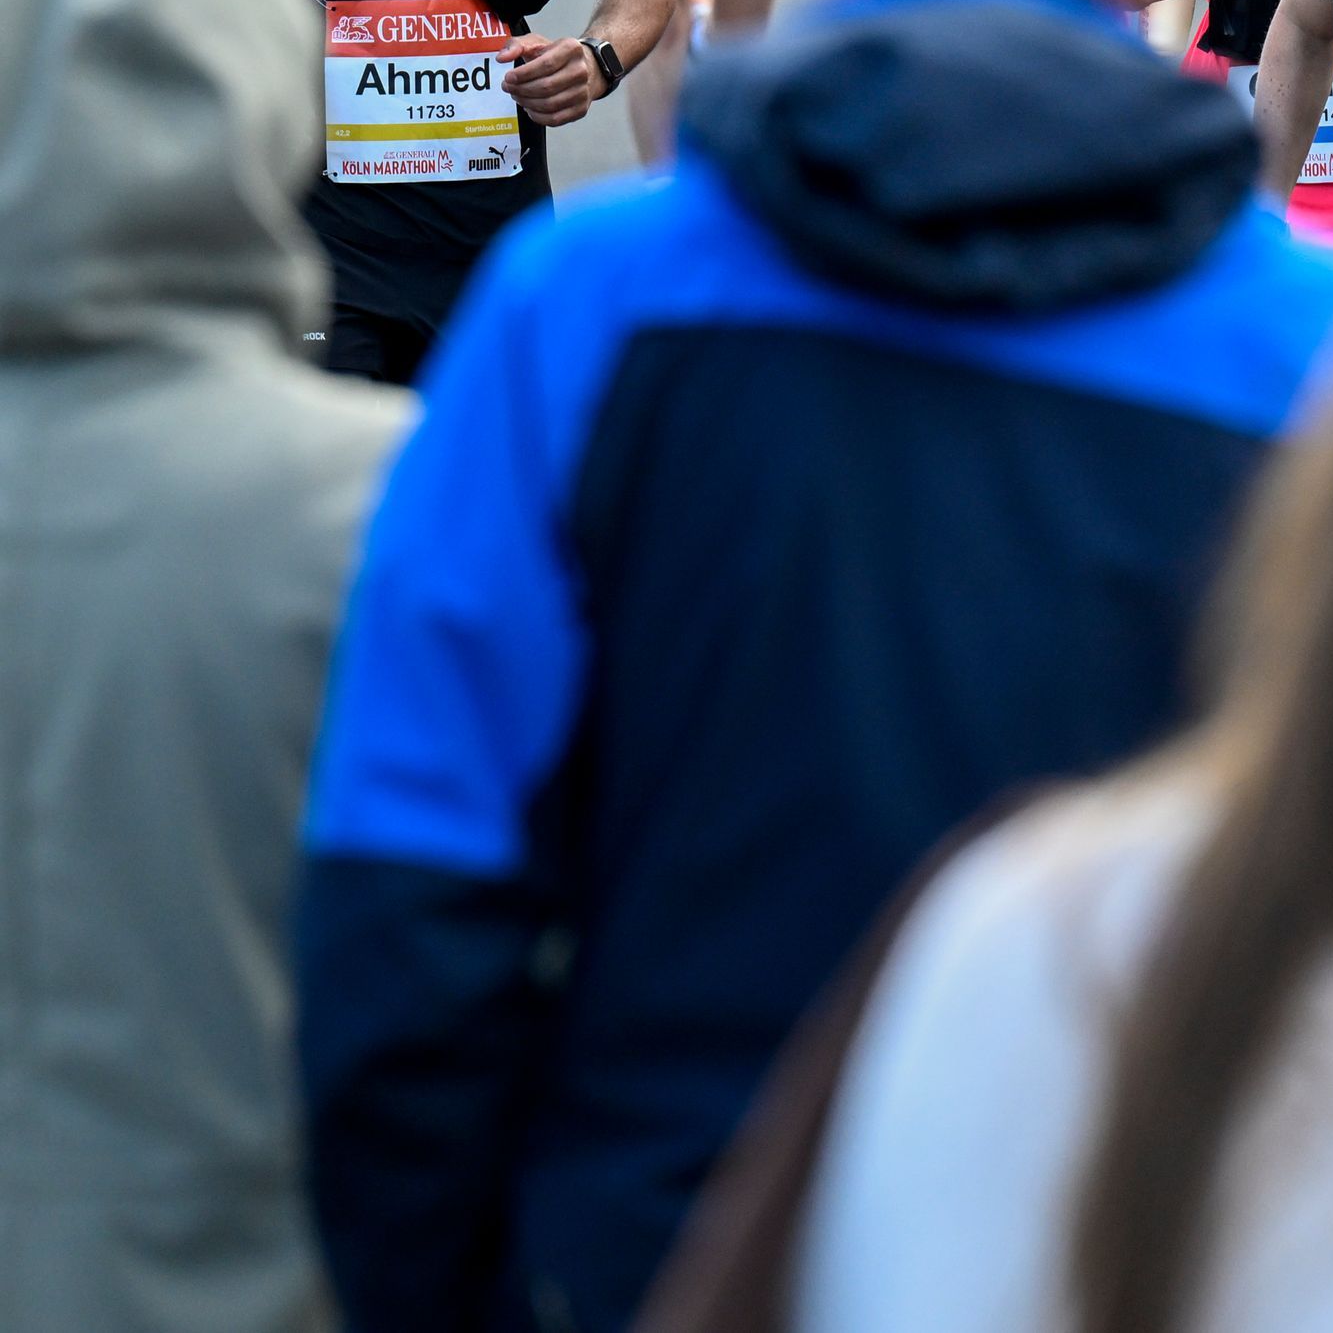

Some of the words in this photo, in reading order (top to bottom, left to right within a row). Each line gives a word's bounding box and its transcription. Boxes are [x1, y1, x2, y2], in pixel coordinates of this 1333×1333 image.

[377, 12, 507, 44] GENERALI
[356, 58, 491, 95] Ahmed
[406, 104, 455, 120] 11733
[395, 150, 436, 158] GENERALI
[342, 160, 371, 175] KÖLN
[374, 159, 436, 175] MARATHON
[469, 157, 501, 171] PUMA
